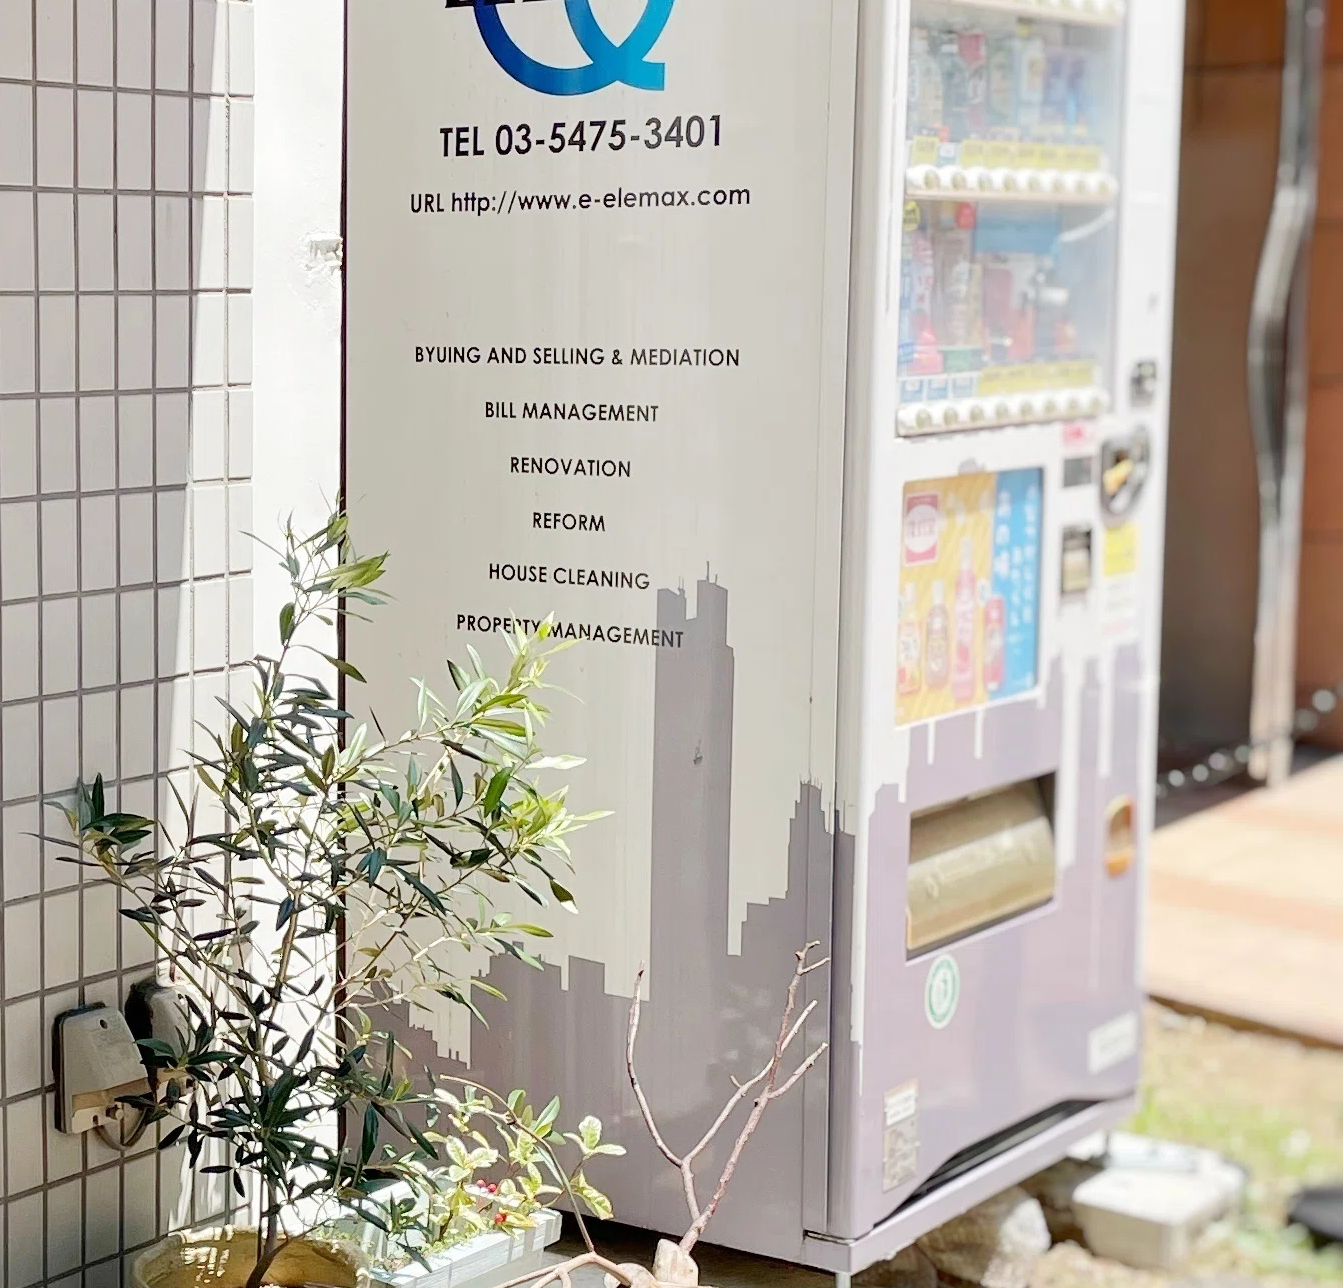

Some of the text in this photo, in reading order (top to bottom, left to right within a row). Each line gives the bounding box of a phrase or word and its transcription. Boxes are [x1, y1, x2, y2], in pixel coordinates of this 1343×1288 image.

[439, 114, 722, 157] TEL 03-5475-3401
[410, 185, 751, 216] URL http://www.e-elemax.com
[415, 346, 740, 367] BYUING AND SELLING & MEDIATION
[485, 401, 659, 422] BILL MANAGEMENT
[510, 457, 631, 478] RENOVATION
[532, 512, 606, 532] REFORM
[489, 563, 650, 590] HOUSE CLEANING
[548, 622, 683, 649] MANAGEMENT
